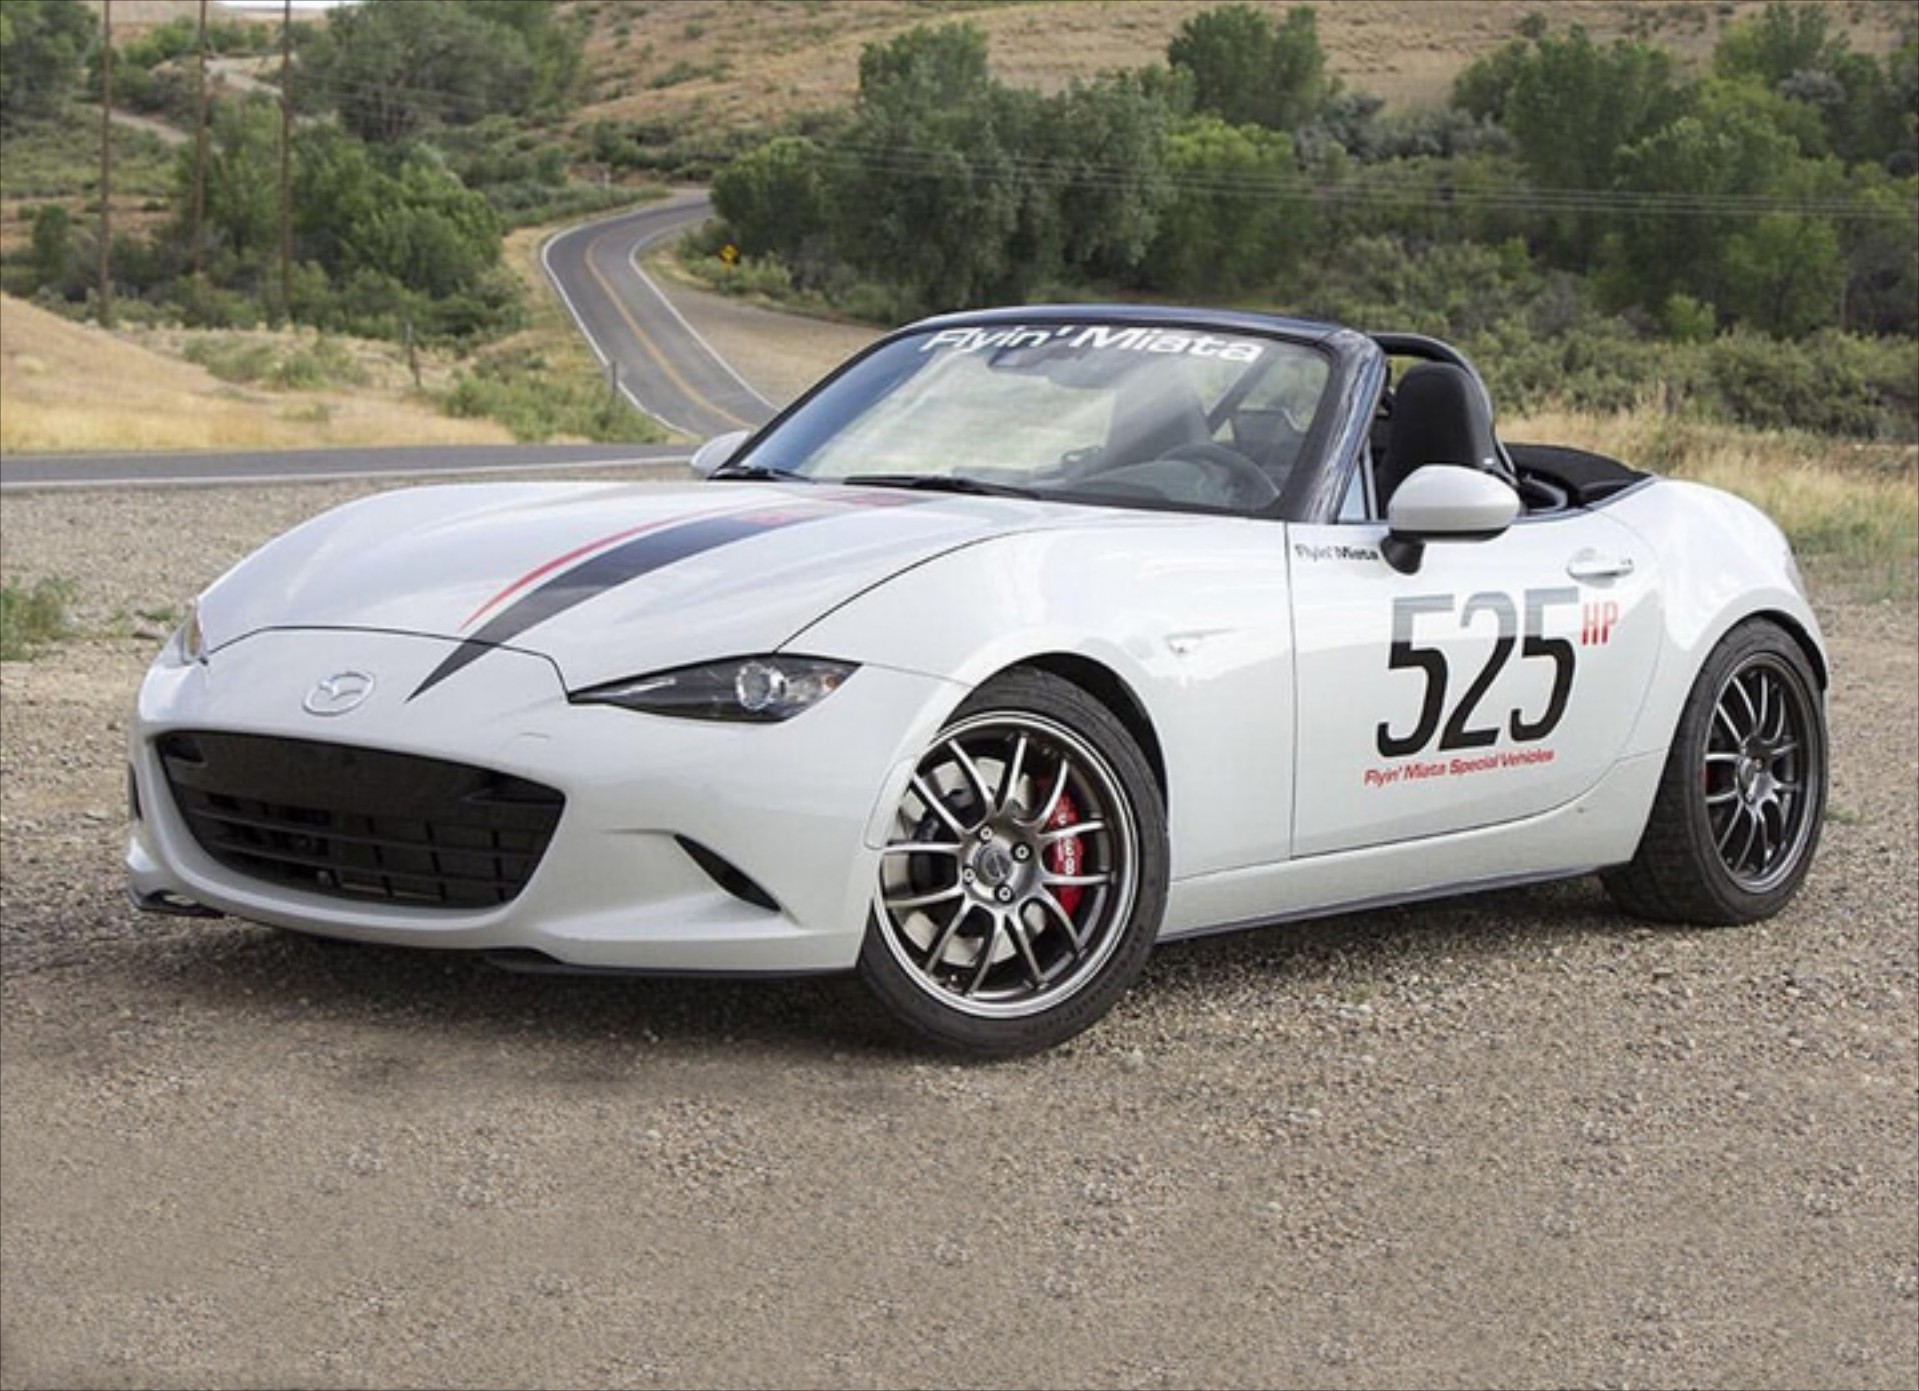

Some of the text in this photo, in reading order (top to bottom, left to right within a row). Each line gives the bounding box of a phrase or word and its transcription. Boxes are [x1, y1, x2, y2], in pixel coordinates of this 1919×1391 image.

[919, 325, 1265, 364] Flyin' Miata
[1376, 586, 1619, 758] 525 HP
[1364, 748, 1555, 788] Flyin' Miata Special Vehicles
